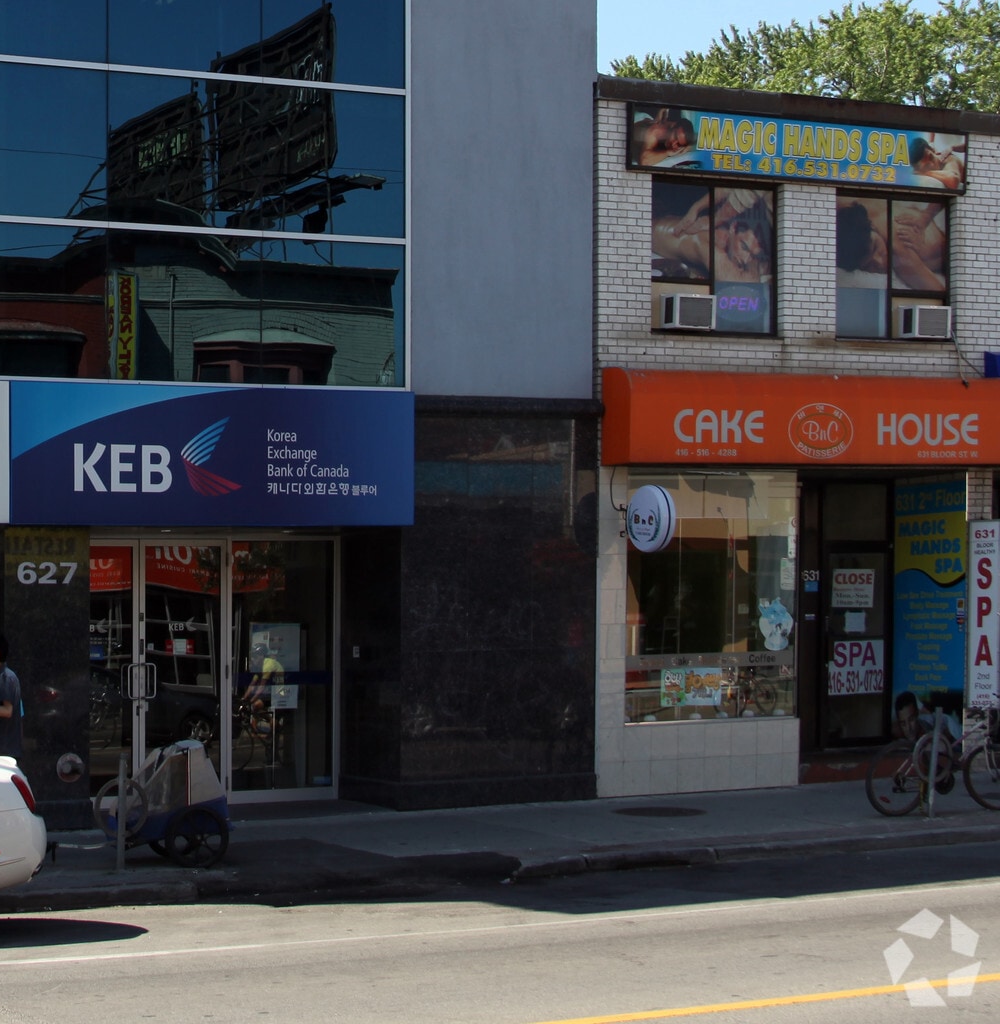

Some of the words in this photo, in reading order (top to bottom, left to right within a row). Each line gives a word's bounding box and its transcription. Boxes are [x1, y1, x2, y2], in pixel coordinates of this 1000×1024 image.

[696, 117, 777, 156] MAGIC
[782, 123, 863, 163] HANDS
[865, 130, 910, 166] SPA
[712, 154, 750, 172] TEL:
[758, 157, 896, 183] 416.531.0732
[719, 296, 760, 312] OPEN
[267, 428, 297, 442] Korea
[673, 408, 765, 444] CAKE
[877, 412, 979, 447] HOUSE
[267, 445, 318, 463] Exchange
[796, 440, 847, 458] PATISSERIE
[930, 450, 957, 458] BLOOR
[73, 442, 173, 494] KEB
[267, 463, 294, 477] Bank
[296, 463, 308, 477] of
[310, 463, 350, 478] Canada
[267, 482, 350, 496] 캐나다외환은행
[899, 518, 946, 537] MAGIC
[975, 529, 995, 539] 631
[910, 537, 962, 556] HANDS
[16, 561, 78, 586] 627
[934, 557, 963, 574] SPA
[834, 573, 873, 585] CLOSE
[168, 623, 185, 632] KEB
[748, 654, 777, 664] Coffee
[833, 641, 877, 669] SPA
